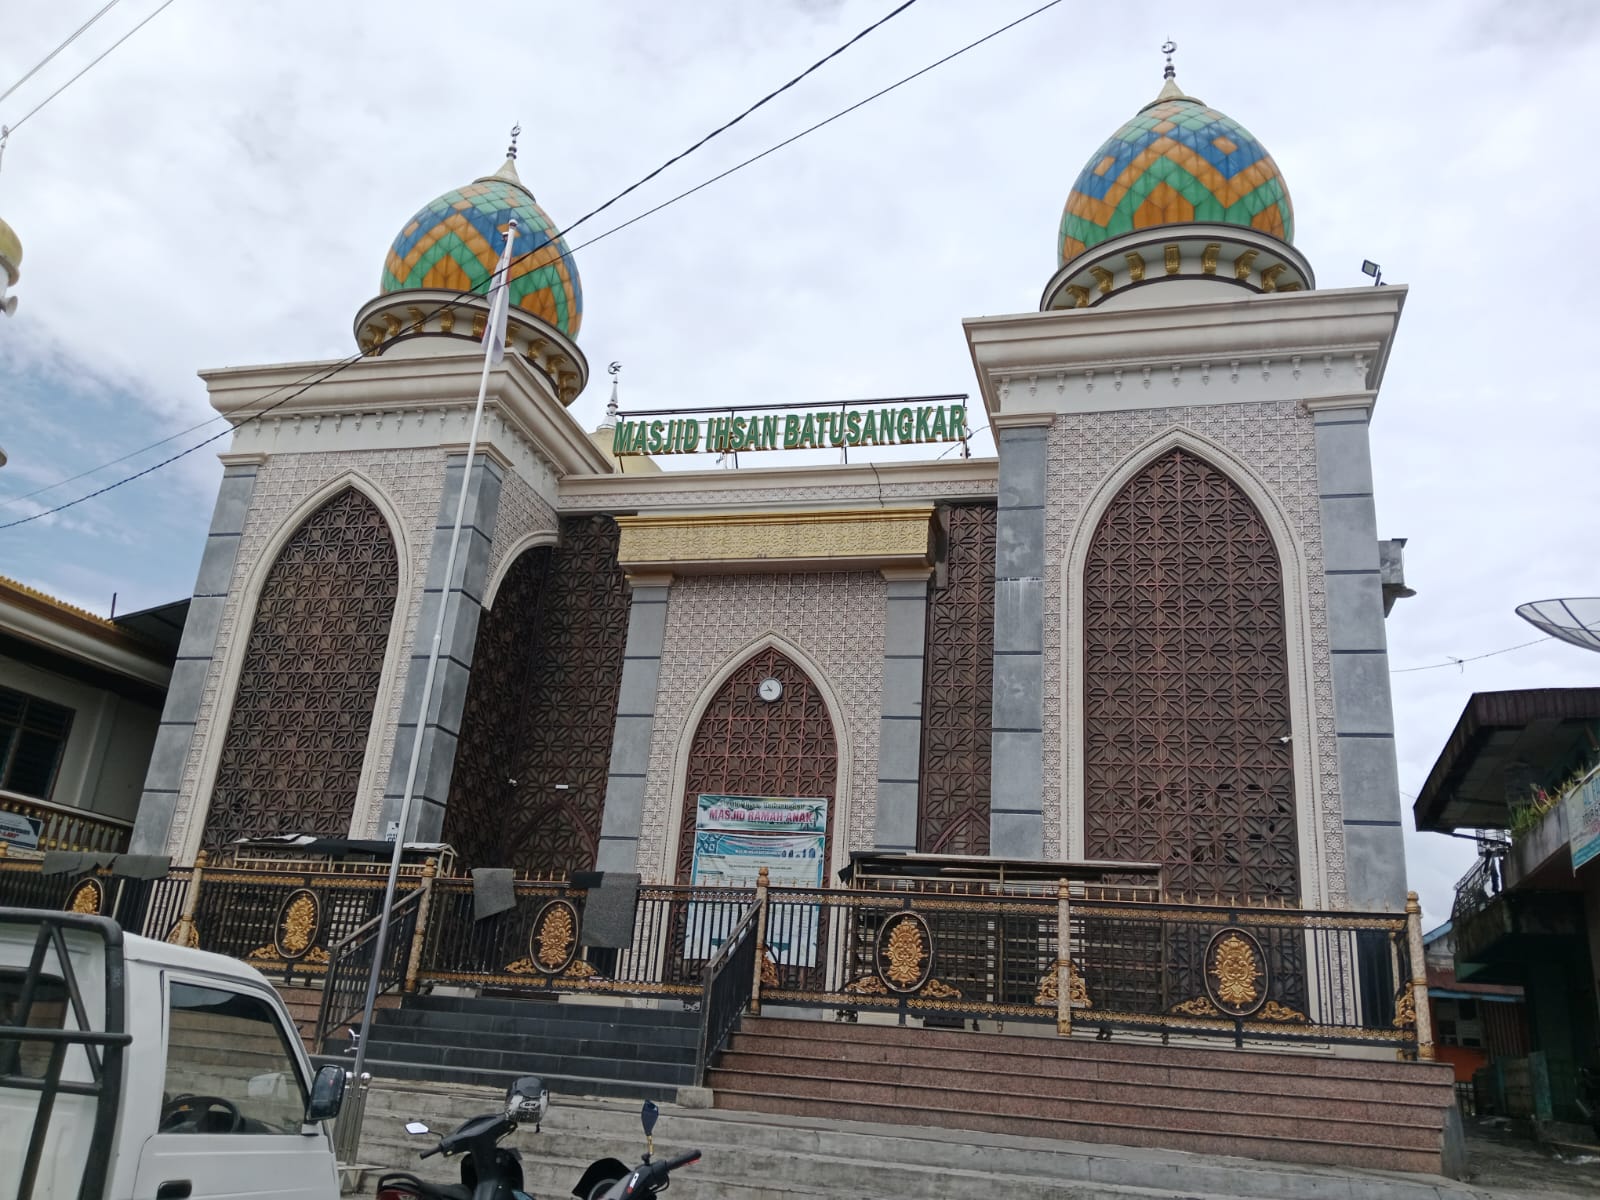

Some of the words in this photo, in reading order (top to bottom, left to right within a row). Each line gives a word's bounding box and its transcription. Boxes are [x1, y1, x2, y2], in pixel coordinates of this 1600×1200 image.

[613, 418, 701, 456] MASJID
[704, 415, 779, 453] IHSAN
[783, 404, 967, 449] BATUSANGKAR
[709, 808, 746, 821] MASJID
[748, 809, 783, 823] RAMAH
[785, 811, 813, 823] ANAK
